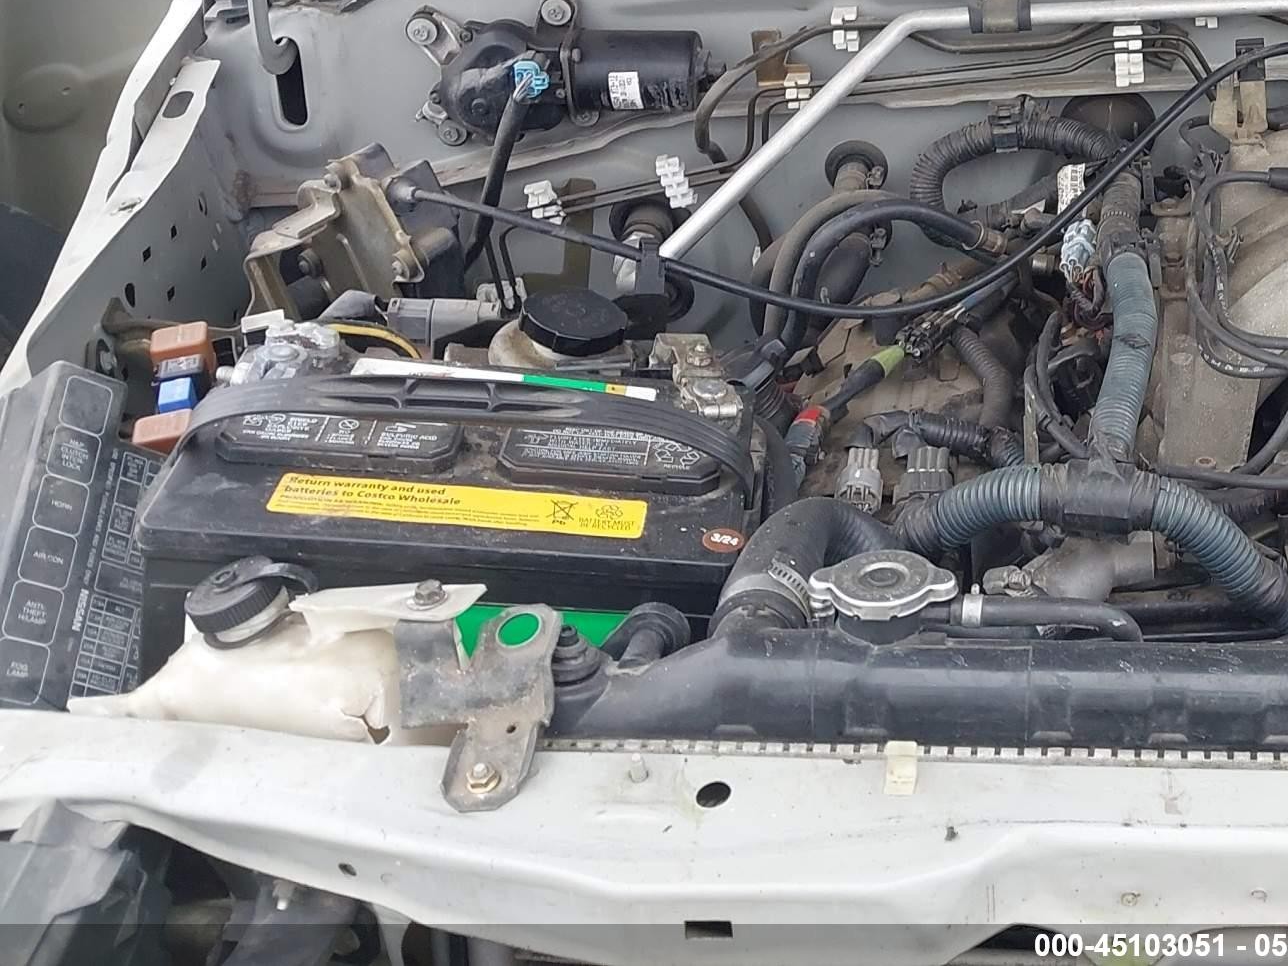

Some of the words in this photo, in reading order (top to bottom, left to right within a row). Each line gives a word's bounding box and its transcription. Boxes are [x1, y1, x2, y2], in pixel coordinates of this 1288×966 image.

[284, 484, 339, 497] batteries
[341, 489, 354, 498] to
[356, 490, 396, 500] Costco
[397, 493, 461, 505] Wholesale
[287, 475, 332, 487] Return
[333, 480, 390, 493] warranty
[391, 482, 415, 493] and
[417, 484, 447, 495] used
[51, 499, 72, 511] HORN
[709, 532, 739, 547] 3/24
[71, 588, 90, 632] NISSAN
